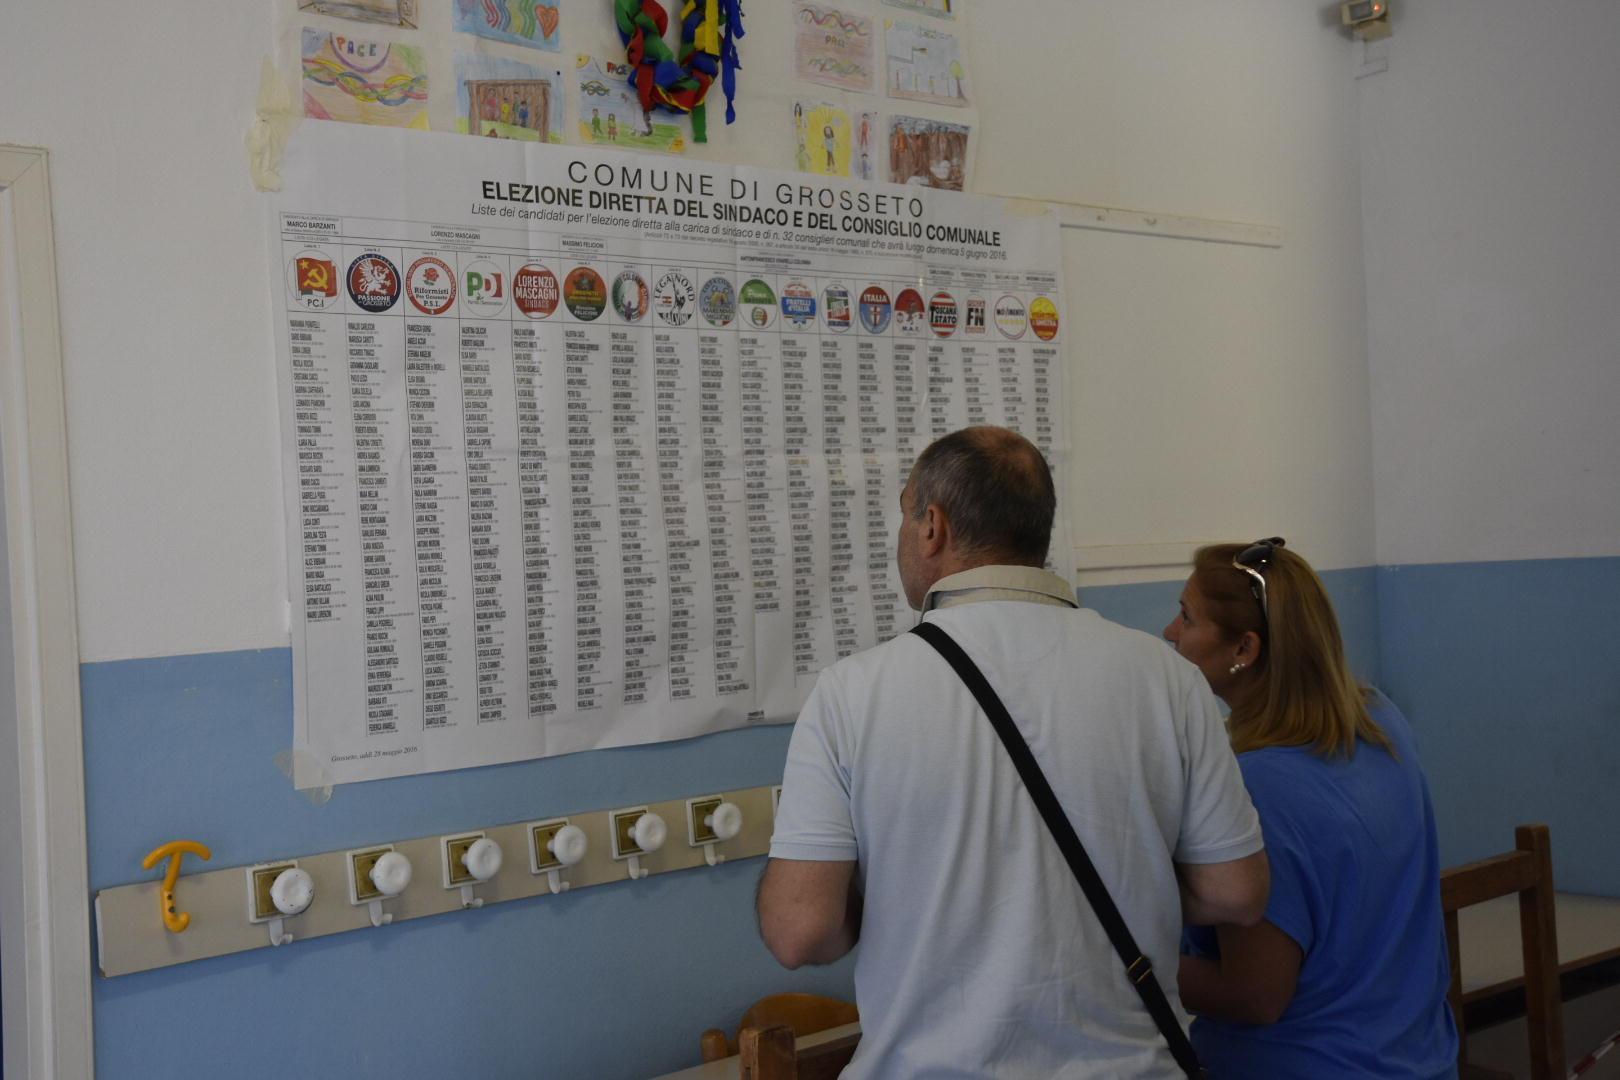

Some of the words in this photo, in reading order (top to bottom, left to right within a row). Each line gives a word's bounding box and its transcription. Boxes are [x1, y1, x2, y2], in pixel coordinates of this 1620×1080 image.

[335, 36, 377, 57] PACE
[568, 161, 713, 197] COMUNE
[730, 178, 758, 202] DI
[776, 184, 923, 217] GROSSETO
[482, 181, 582, 207] ELEZIONE
[589, 190, 668, 214] DIRETTA
[674, 199, 708, 218] DEL
[713, 203, 788, 226] SINDACO
[793, 211, 803, 227] E
[808, 213, 838, 232] DEL
[842, 216, 922, 239] CONSIGLIO
[926, 225, 1001, 247] COMUNALE
[287, 220, 307, 229] MARCO
[308, 221, 336, 231] BARZANTI
[471, 203, 497, 216] Liste
[499, 205, 515, 217] dei
[518, 207, 565, 220] candidati
[568, 212, 584, 224] per
[586, 213, 630, 226] l'elezione
[631, 215, 662, 229] diretta
[665, 221, 681, 231] alla
[683, 223, 710, 234] carica
[712, 224, 720, 235] di
[722, 226, 753, 239] sindaco
[764, 229, 772, 239] di
[772, 232, 780, 240] n.
[783, 231, 793, 241] 32
[795, 233, 835, 247] consiglieri
[836, 236, 869, 248] comunali
[871, 239, 886, 250] che
[888, 240, 904, 251] avrà
[906, 241, 925, 254] luogo
[926, 243, 959, 256] domenica
[960, 246, 966, 256] 5
[966, 247, 988, 260] giugno
[430, 231, 454, 239] LORENZO
[455, 232, 480, 240] MASCAGNI
[467, 271, 503, 298] PD
[518, 275, 554, 288] LORENZO
[655, 275, 677, 299] LEGA
[676, 273, 696, 302] NORD
[414, 288, 449, 296] Riformisti
[515, 288, 558, 300] MASCAGNI
[524, 299, 549, 308] SINDACO
[930, 306, 957, 317] TOSCANA
[966, 307, 986, 326] FN
[935, 315, 958, 324] STATO
[331, 753, 359, 763] Grosseto,
[404, 746, 418, 754] 2016
